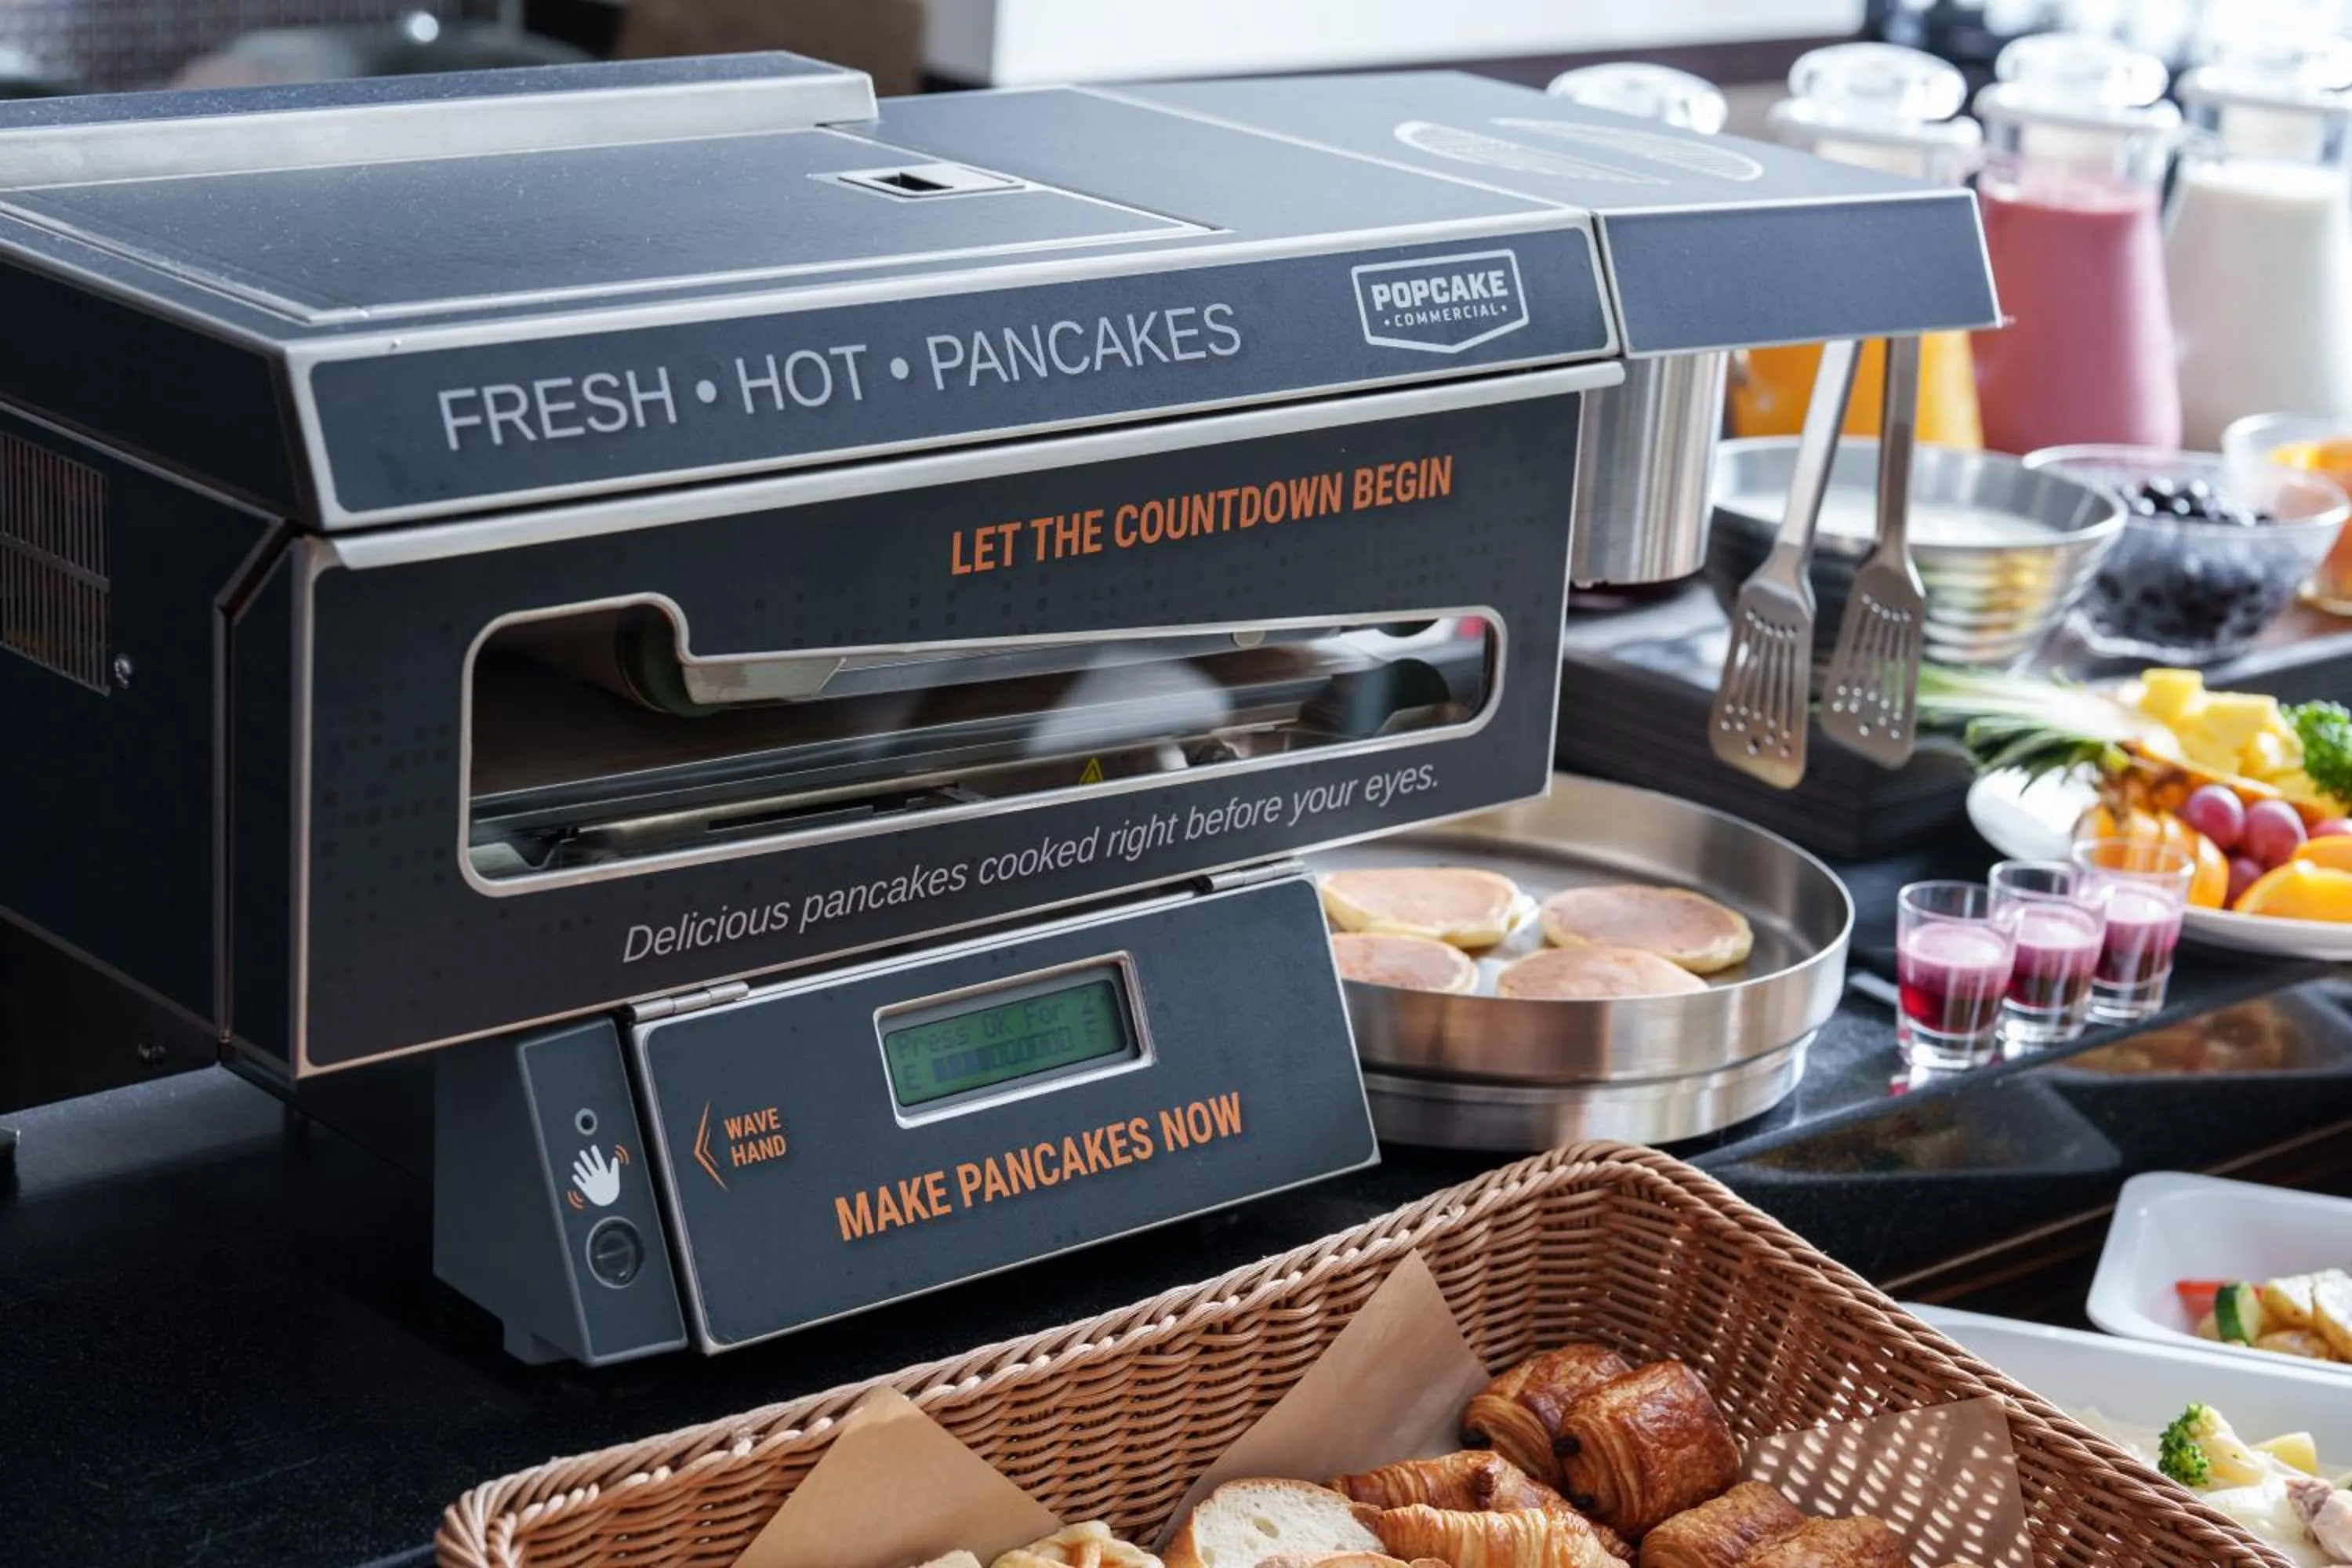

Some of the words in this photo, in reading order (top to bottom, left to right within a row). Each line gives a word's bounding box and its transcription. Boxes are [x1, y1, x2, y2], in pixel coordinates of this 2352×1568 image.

[1370, 270, 1508, 311] POPCAKE
[1394, 305, 1499, 327] COMMERCIAL
[437, 366, 678, 451] FRESH
[735, 344, 866, 414] HOT
[926, 303, 1242, 390] PANCAKES
[951, 522, 1021, 575] LET
[1030, 510, 1103, 561] THE
[1114, 473, 1341, 548] COUNTDOWN
[1352, 455, 1453, 511] BEGIN
[622, 901, 790, 963] Delicious
[799, 862, 967, 934] pancakes
[978, 826, 1100, 884] cooked
[1106, 811, 1178, 862] right
[1185, 796, 1282, 840] before
[1288, 779, 1358, 827] your
[1364, 764, 1438, 808] eyes.
[724, 1107, 782, 1140] WAVE
[731, 1134, 786, 1167] HAND
[834, 1171, 952, 1241] MAKE
[956, 1116, 1153, 1208] PANCAKES
[1160, 1091, 1242, 1152] NOW
